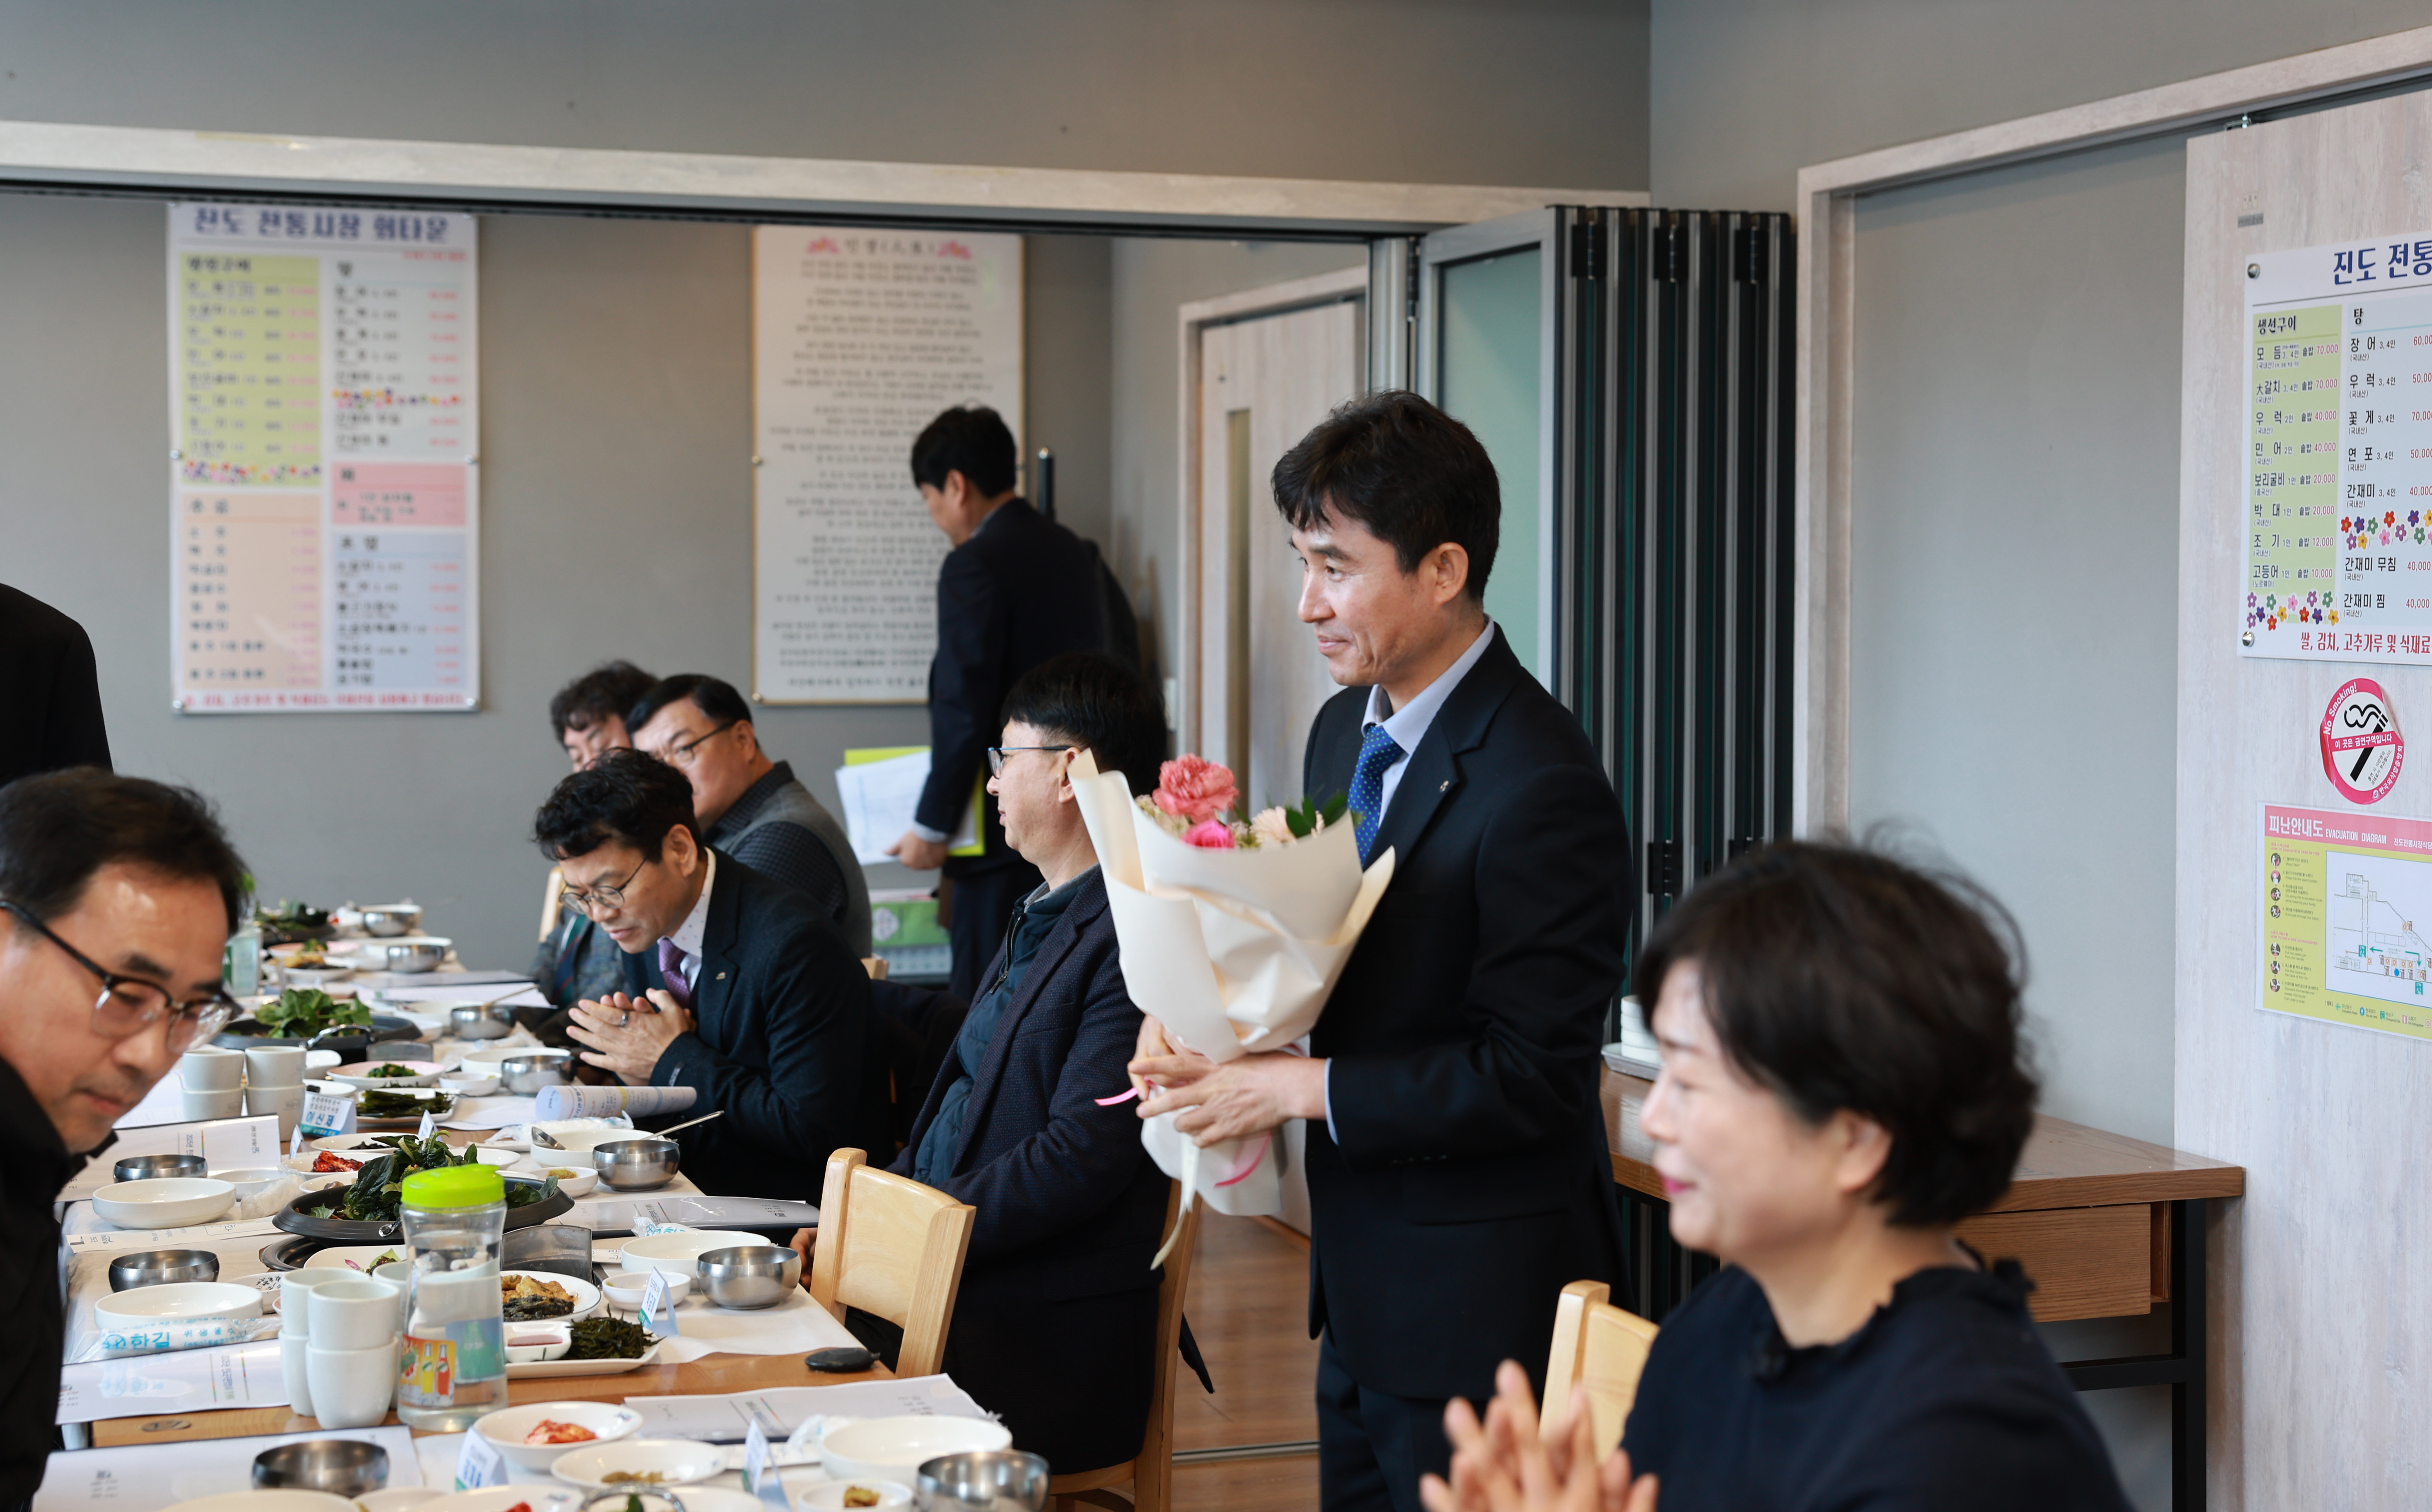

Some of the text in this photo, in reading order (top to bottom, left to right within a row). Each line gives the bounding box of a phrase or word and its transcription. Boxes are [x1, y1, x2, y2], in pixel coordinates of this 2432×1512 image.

[2333, 248, 2376, 285] 진도
[2354, 308, 2363, 325] 탕
[2258, 315, 2296, 335] 생선구이
[2317, 344, 2338, 355] 70,000
[2350, 353, 2369, 362] (국내산)
[2256, 380, 2280, 395] 大갈치
[2290, 383, 2298, 392] 4인
[2316, 378, 2338, 389] 70,000
[2256, 396, 2273, 404] (국내산)
[2350, 390, 2368, 398] (국내산)
[2315, 410, 2337, 421] 40,000
[2412, 410, 2432, 422] 70,00
[2314, 442, 2336, 453] 40,000
[2255, 457, 2272, 465] (국내산)
[2348, 463, 2366, 472] (국내산)
[2255, 472, 2284, 487] 보리굴비
[2288, 477, 2296, 485] 1인
[2313, 474, 2335, 485] 20,000
[2347, 483, 2375, 499] 간재미
[2386, 488, 2396, 497] 4인
[2313, 505, 2335, 516] 20,000
[2347, 500, 2365, 508] (국내산)
[2313, 537, 2334, 547] 12,000
[2345, 556, 2431, 572] 간재미 무침 40,000
[2253, 565, 2278, 579] 고등어
[2282, 569, 2289, 578] 1인
[2312, 569, 2333, 579] 10,000
[2345, 573, 2363, 581] (국내산)
[2344, 594, 2430, 609] 간재미 찜 40,000
[2343, 609, 2362, 618] (국내산)
[2301, 632, 2313, 651] 쌀,
[2318, 632, 2339, 652] 김치,
[2343, 632, 2383, 653] 고추가루
[2387, 635, 2396, 654] 및
[2323, 682, 2357, 735] No Smoking!
[2335, 732, 2392, 749] 이 곳은 금연구역입니다
[2379, 745, 2403, 795] 한국외식업중앙회
[2269, 815, 2323, 838] 피난안내도
[2325, 828, 2358, 841] EVACUATION
[2362, 833, 2387, 844] DIAGRAM
[131, 1332, 170, 1350] 한길
